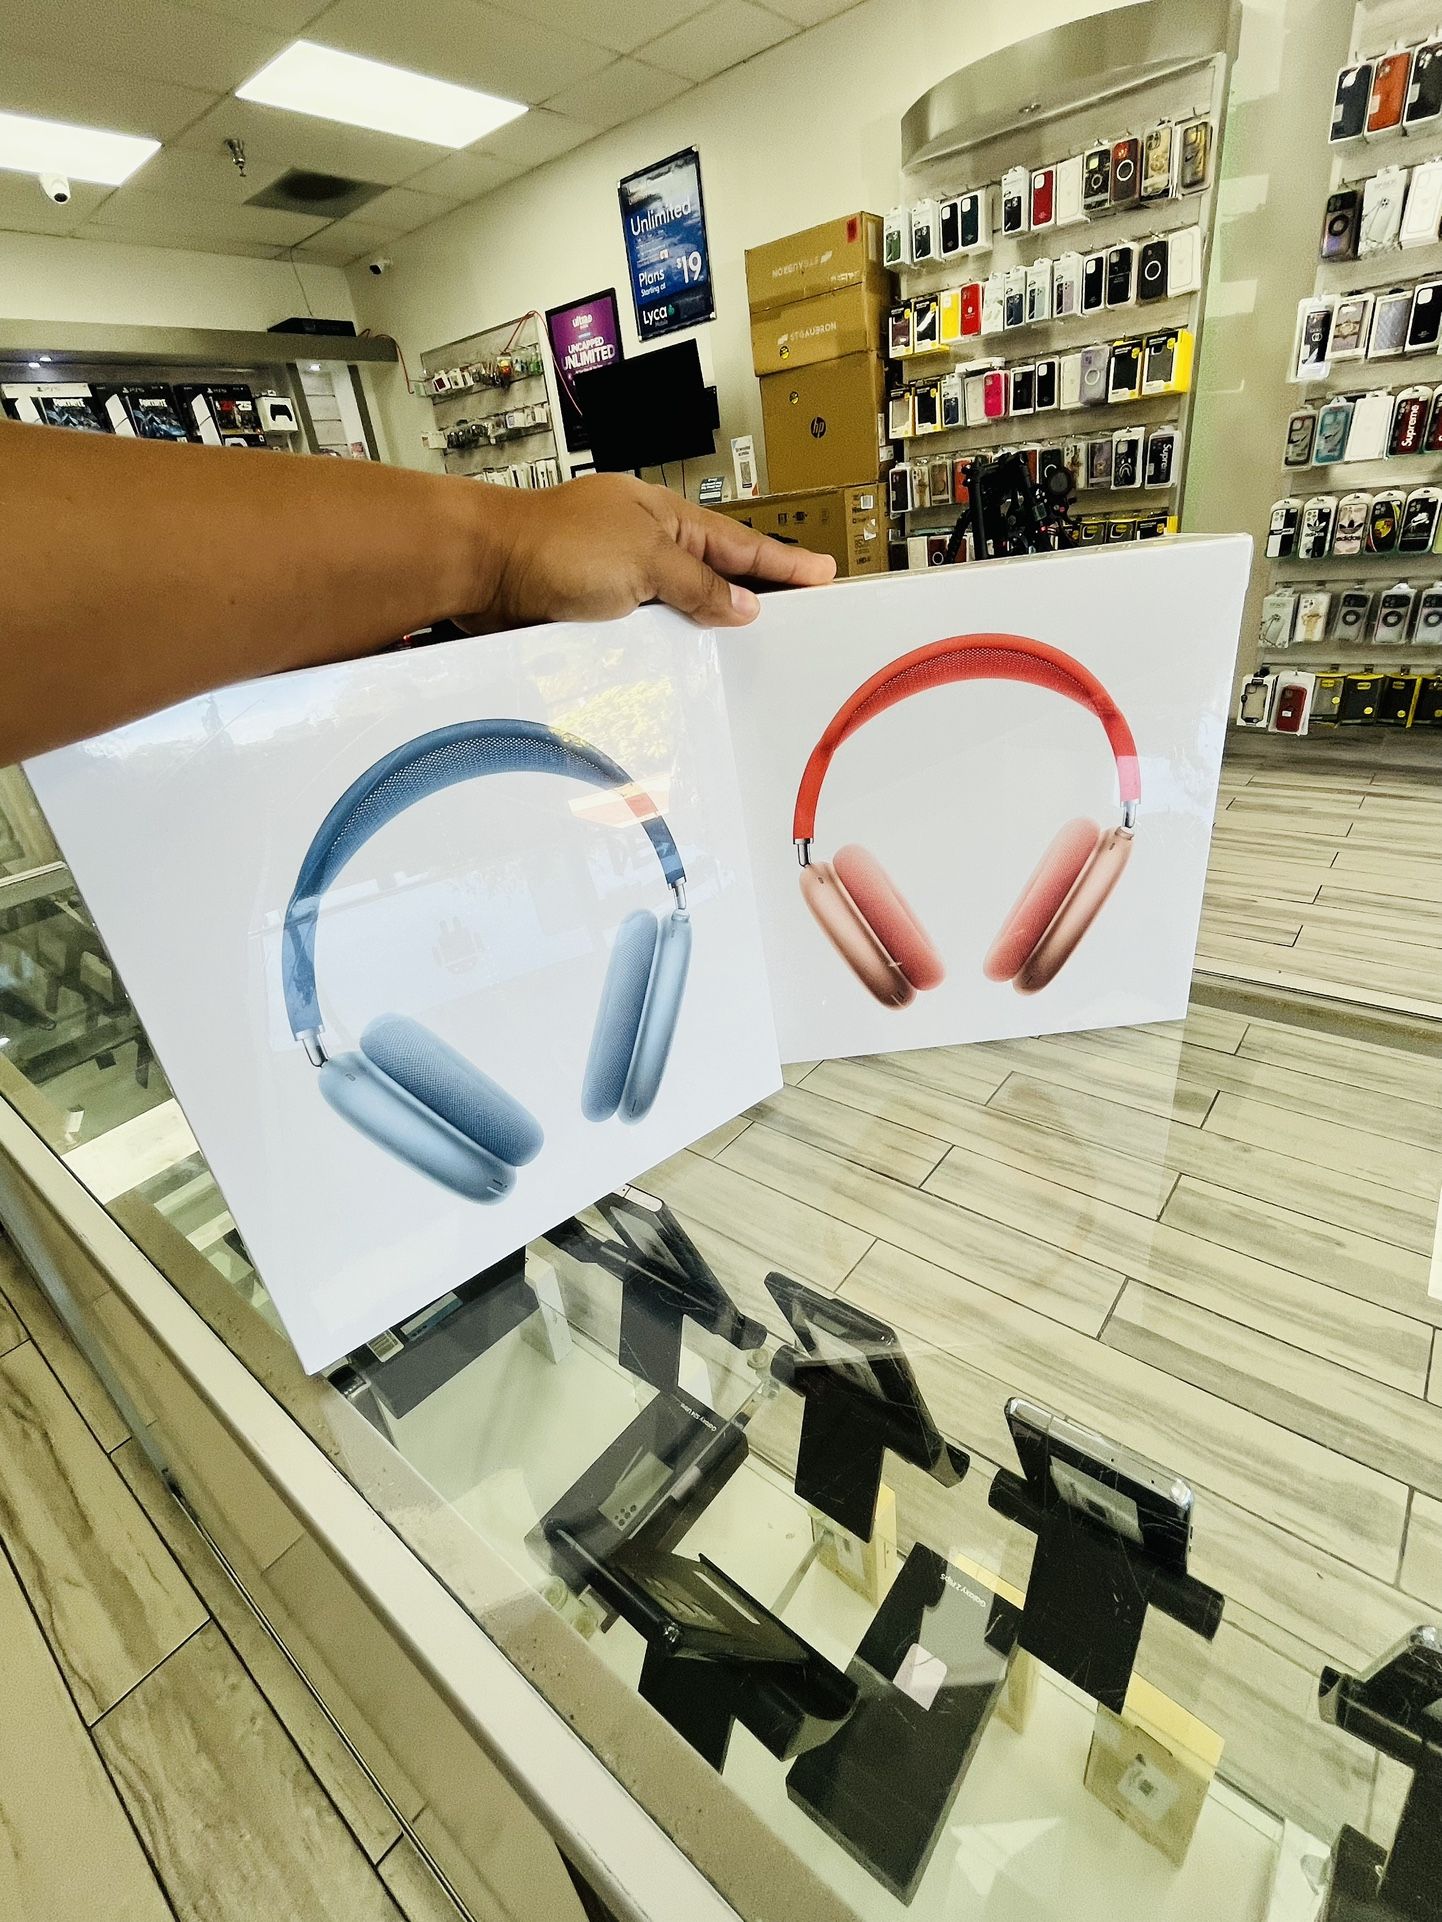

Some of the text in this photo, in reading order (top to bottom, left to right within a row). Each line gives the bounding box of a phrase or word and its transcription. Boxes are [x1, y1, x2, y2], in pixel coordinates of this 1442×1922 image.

[630, 196, 692, 236] Unlimited
[676, 250, 703, 284] $19
[638, 270, 665, 288] Plans
[640, 284, 667, 298] Starting at
[642, 304, 668, 326] Lyca
[567, 336, 605, 355] UNCAPPED
[560, 343, 616, 371] UNLIMITED
[811, 416, 827, 439] hp
[1400, 404, 1420, 447] Supreme
[1336, 534, 1361, 542] adidas
[700, 1417, 716, 1431] Galaxy
[955, 1583, 962, 1591] Z
[961, 1587, 986, 1607] Galaxy
